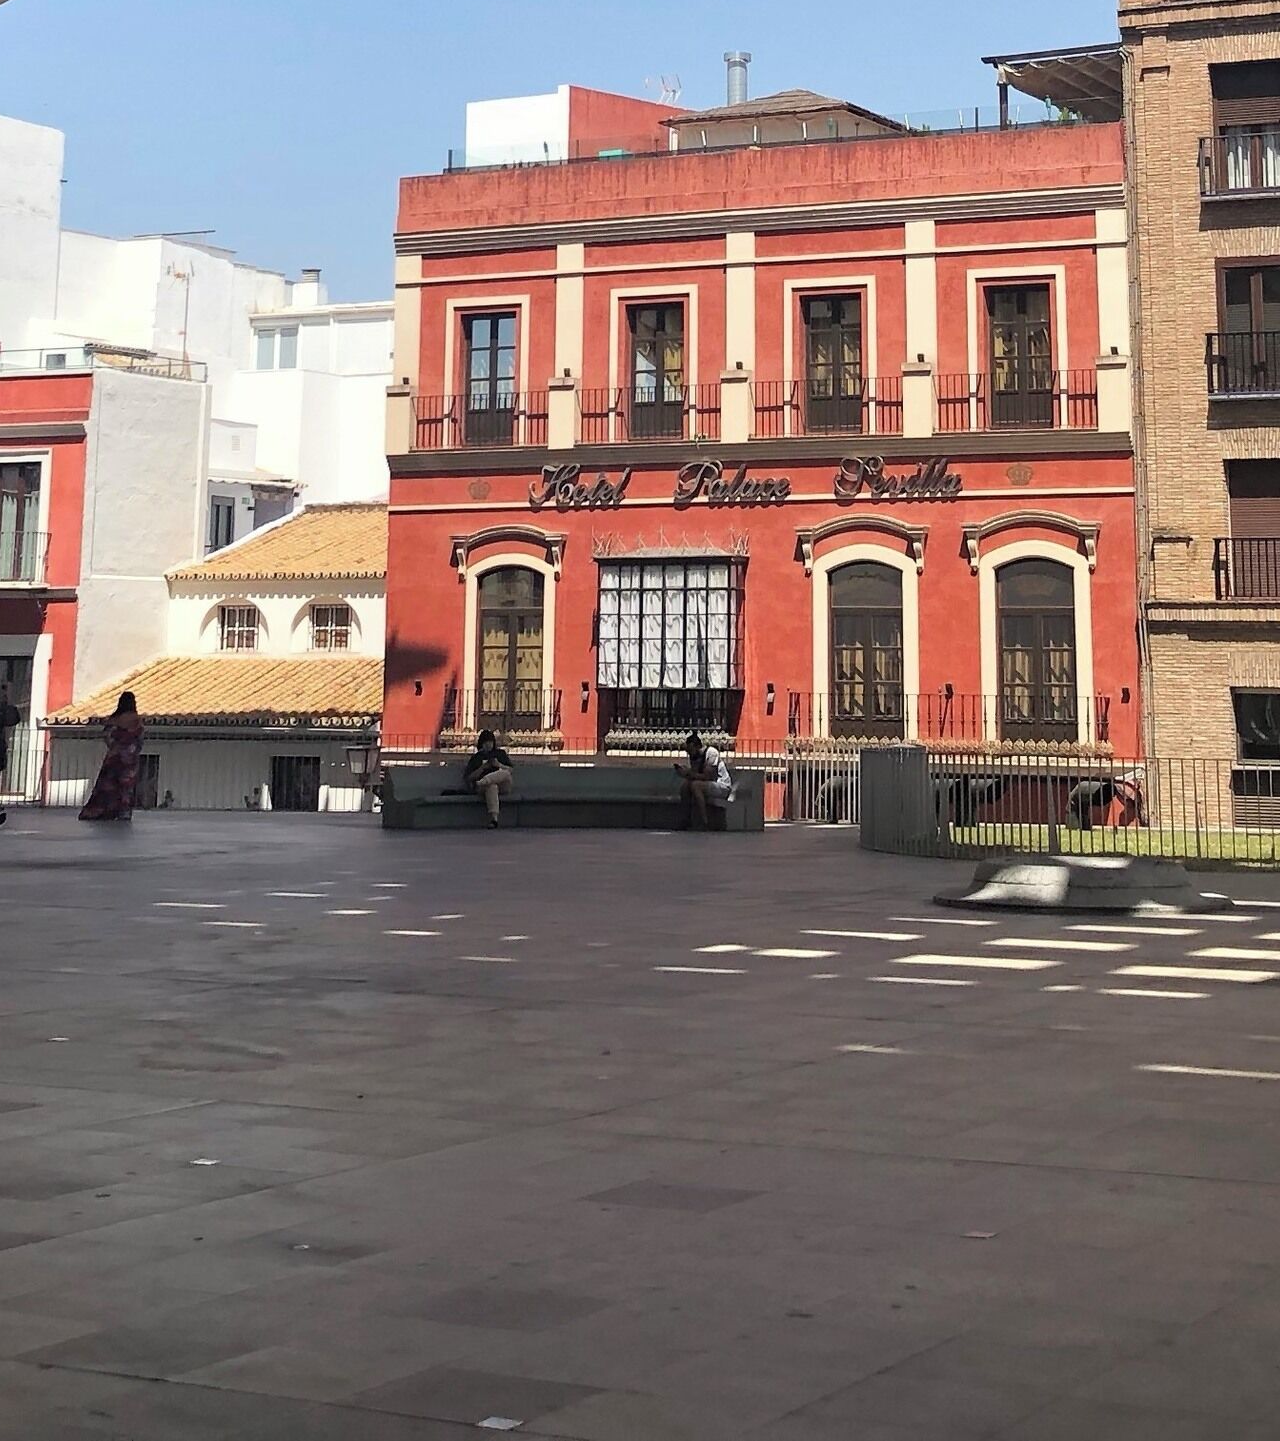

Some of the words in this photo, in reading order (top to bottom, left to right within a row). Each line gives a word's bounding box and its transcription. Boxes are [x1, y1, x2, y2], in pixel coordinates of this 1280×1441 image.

[529, 464, 631, 507] Hotel
[673, 460, 791, 506] Palace
[834, 456, 963, 502] Sevilla
